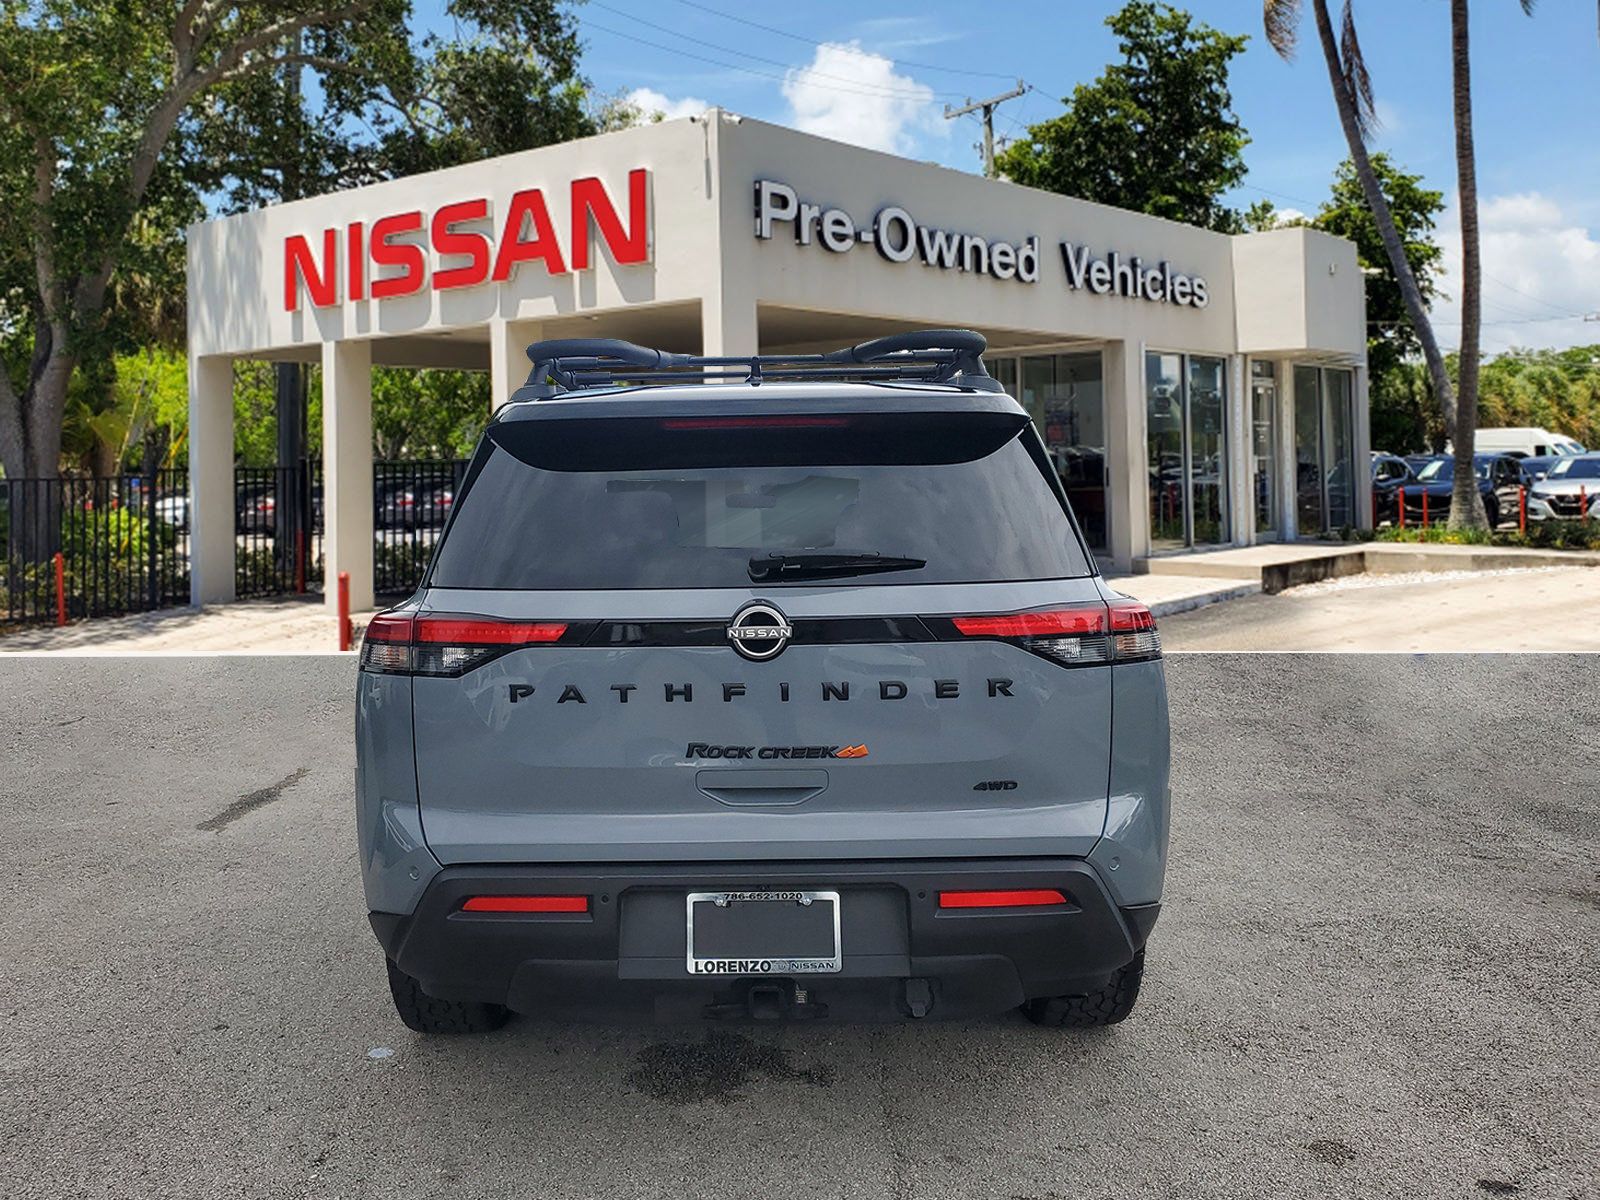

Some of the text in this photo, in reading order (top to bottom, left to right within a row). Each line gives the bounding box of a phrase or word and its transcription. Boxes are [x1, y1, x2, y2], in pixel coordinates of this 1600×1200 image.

[285, 168, 648, 312] NISSAN
[755, 180, 1209, 308] Pre-Owned Vehicles
[727, 628, 791, 638] NISSAN
[508, 677, 1014, 705] PATHFINDER
[973, 781, 1018, 791] 4WD
[724, 892, 803, 901] 786-652-1020
[694, 960, 835, 973] LORENZO NISSAN
